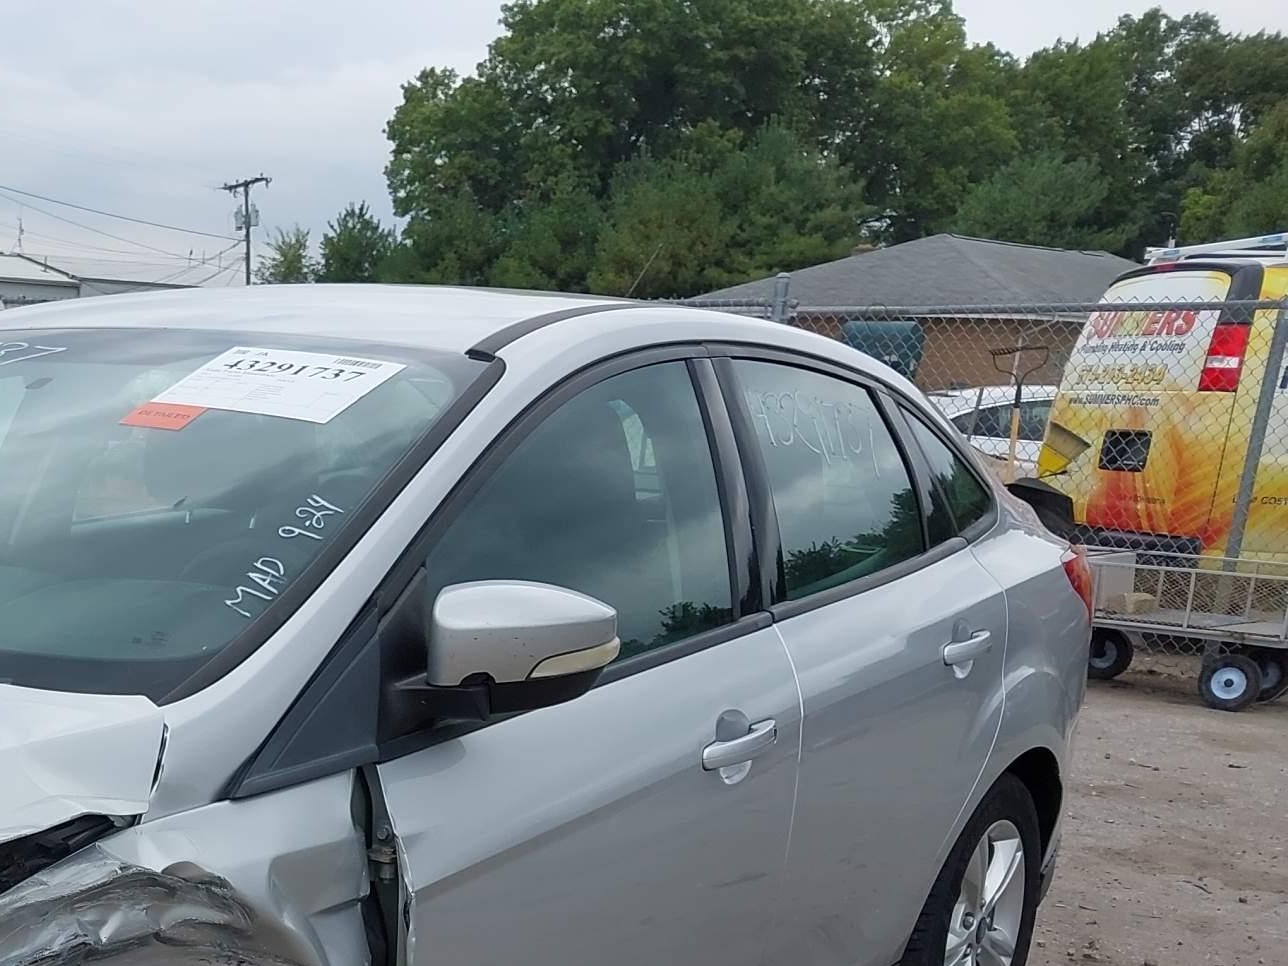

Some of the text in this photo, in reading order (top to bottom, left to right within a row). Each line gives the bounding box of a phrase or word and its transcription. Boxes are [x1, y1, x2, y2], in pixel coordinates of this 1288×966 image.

[1149, 340, 1186, 354] Cooling
[223, 358, 367, 382] 43291737
[224, 556, 287, 617] MAD
